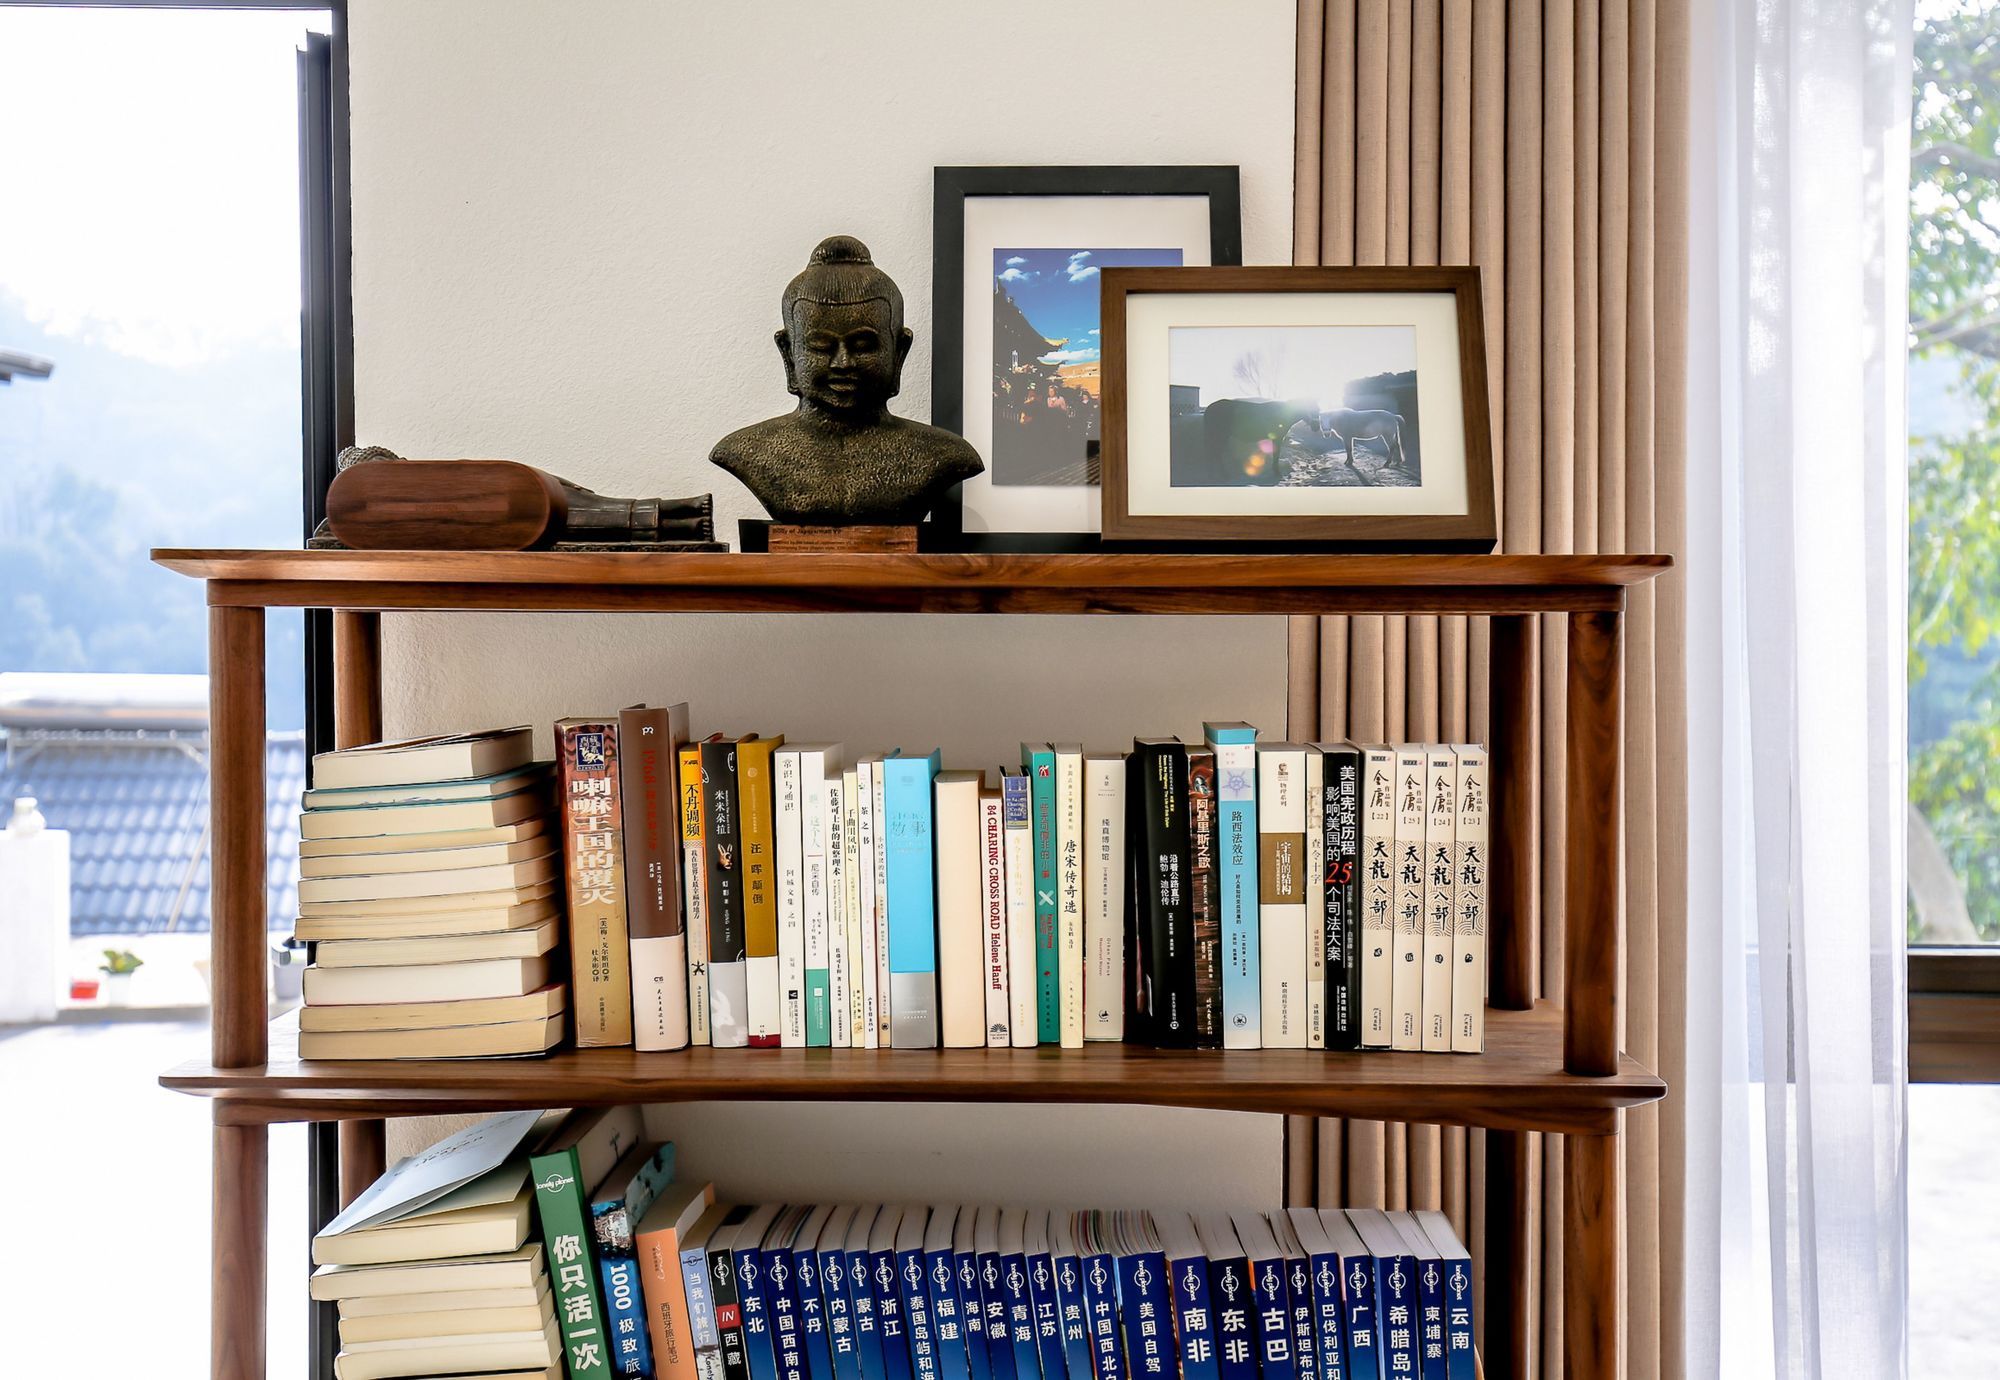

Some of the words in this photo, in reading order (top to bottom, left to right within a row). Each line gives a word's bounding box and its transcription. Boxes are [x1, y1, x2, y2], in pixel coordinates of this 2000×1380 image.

[783, 759, 794, 811] 常识与通识
[685, 783, 700, 837] 不丹调频
[715, 790, 727, 835] 米米朵拉
[861, 806, 870, 845] 茶之书
[987, 805, 997, 816] 84
[573, 777, 616, 905] 喇嘛王国的覆灭
[830, 789, 841, 876] 佐藤可士和的超整理术
[988, 817, 999, 866] CHARING
[1101, 818, 1111, 861] 纯真博物馆
[1196, 799, 1211, 869] 阿基里斯之歌
[1231, 810, 1243, 867] 路西法效应
[811, 864, 820, 896] 尼采自传
[989, 867, 1000, 899] CROSS
[1064, 840, 1078, 914] 唐宋传奇选
[1159, 854, 1170, 906] 鲍勃·迪伦传
[1169, 854, 1180, 906] 沿着公路直行
[1281, 841, 1292, 896] 宇宙的结构
[990, 901, 1001, 930] ROAD
[991, 933, 1001, 963] Helene
[992, 965, 1003, 991] Hanff
[552, 1234, 601, 1371] 你只活一次
[610, 1263, 632, 1311] 1000
[690, 1272, 711, 1346] 当我们旅行
[660, 1302, 679, 1365] 西班牙旅行笔记
[722, 1311, 734, 1322] IN
[745, 1296, 765, 1334] 东北
[803, 1298, 822, 1333] 不丹
[831, 1298, 852, 1353] 内蒙古
[856, 1297, 874, 1332] 蒙古
[881, 1298, 901, 1337] 浙江
[937, 1298, 959, 1341] 福建
[965, 1301, 981, 1332] 海南
[987, 1302, 1007, 1340] 安徽
[1011, 1305, 1032, 1343] 青海
[1038, 1303, 1057, 1337] 江苏
[1065, 1305, 1083, 1341] 贵州
[1183, 1307, 1211, 1363] 南非
[1221, 1308, 1250, 1364] 东非
[1262, 1307, 1290, 1362] 古巴
[1352, 1305, 1371, 1348] 广西
[1424, 1306, 1442, 1359] 柬埔寨
[1450, 1307, 1471, 1350] 云南
[724, 1332, 742, 1366] 西藏
[1139, 1302, 1161, 1373] 美国自驾
